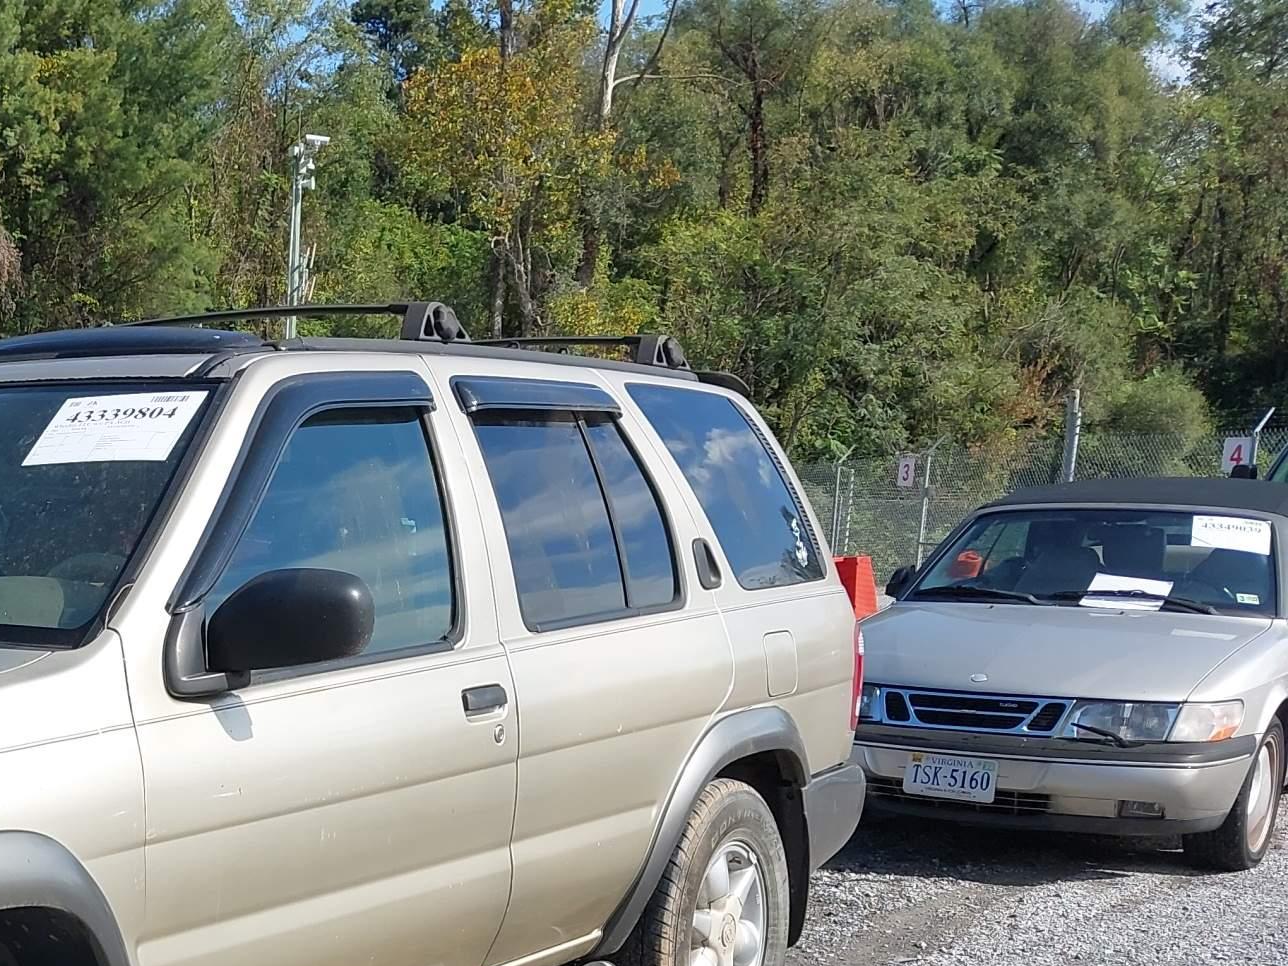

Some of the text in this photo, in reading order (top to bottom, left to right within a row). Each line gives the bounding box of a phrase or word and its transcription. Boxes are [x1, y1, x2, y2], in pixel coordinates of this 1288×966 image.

[65, 406, 178, 423] 43339804
[1229, 444, 1243, 465] 4
[902, 463, 910, 482] 3
[932, 757, 974, 768] VIRGINIA
[912, 763, 991, 791] TSK-5160
